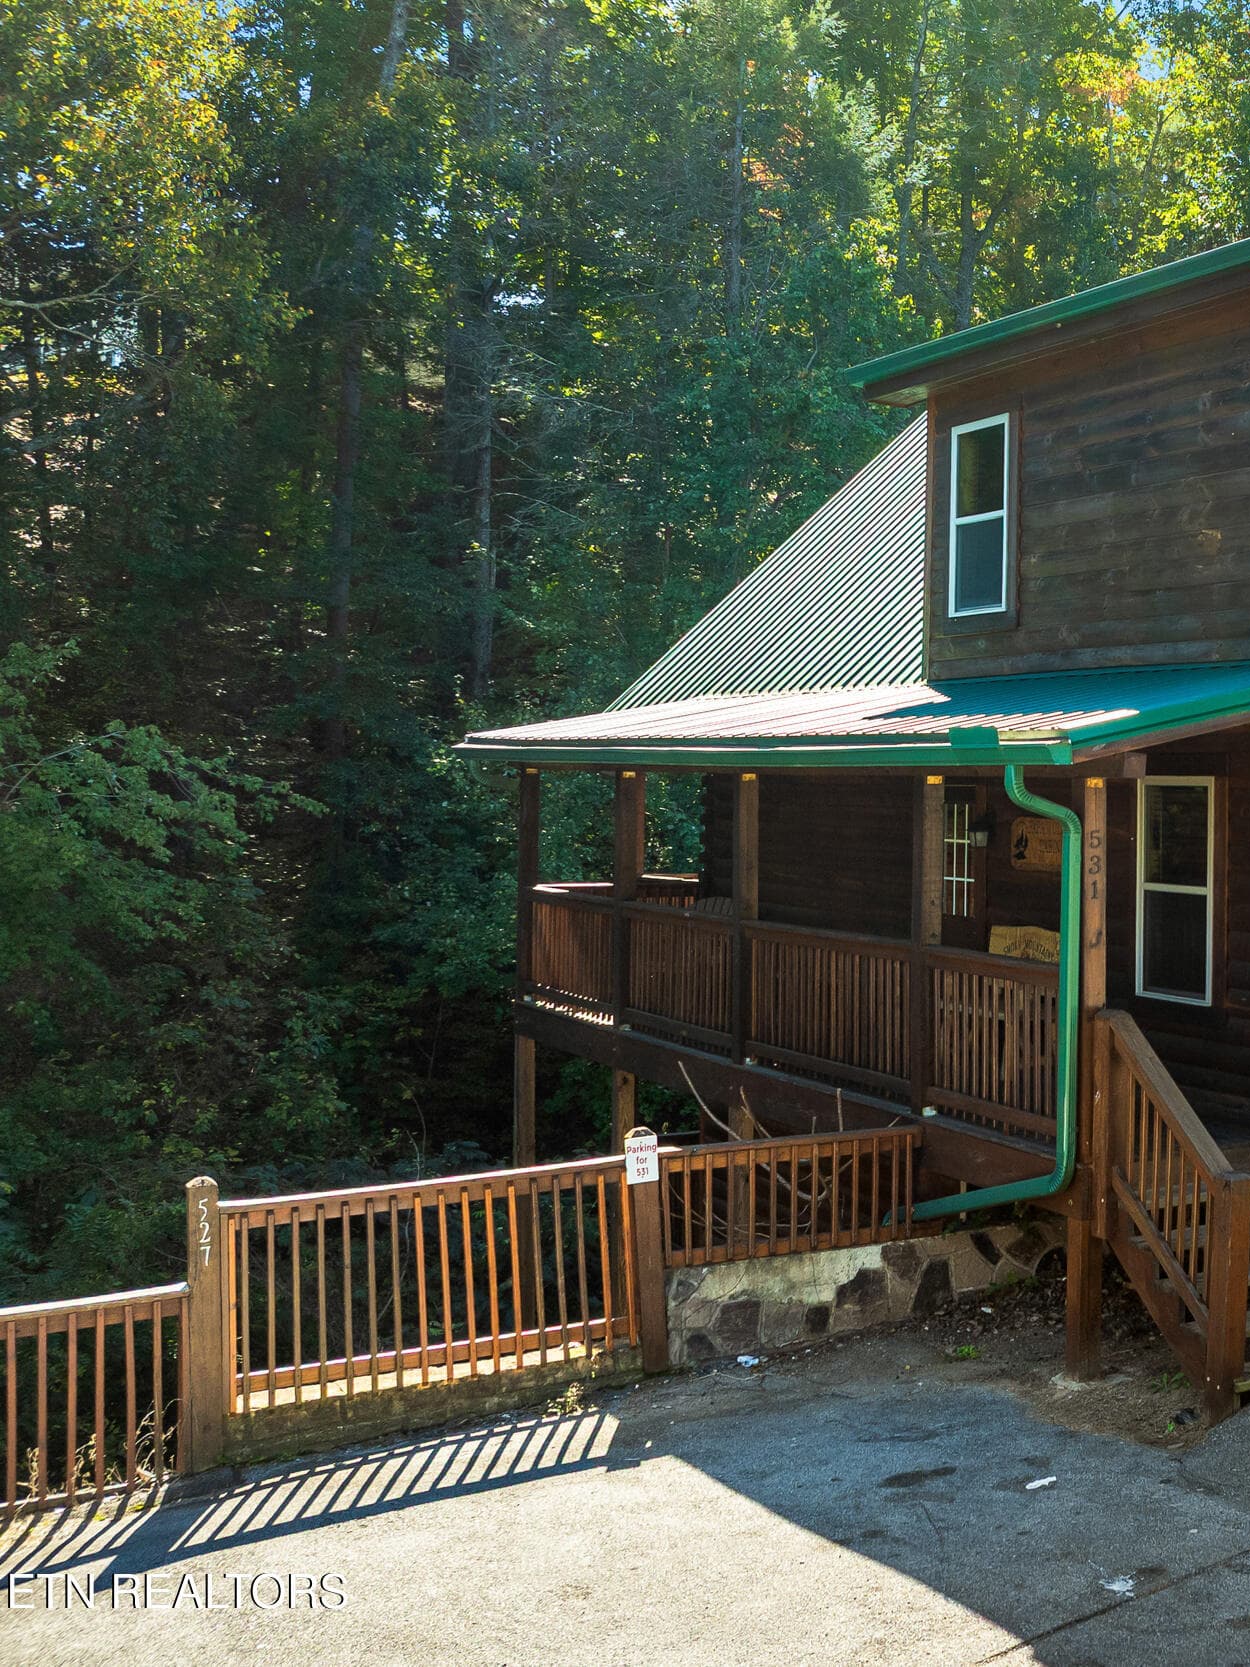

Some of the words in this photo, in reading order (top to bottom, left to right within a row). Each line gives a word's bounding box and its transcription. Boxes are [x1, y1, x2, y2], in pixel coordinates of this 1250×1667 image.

[1088, 829, 1102, 900] 531
[627, 1143, 657, 1153] Parking
[636, 1156, 647, 1164] for
[636, 1167, 649, 1176] 531
[198, 1198, 211, 1266] 527
